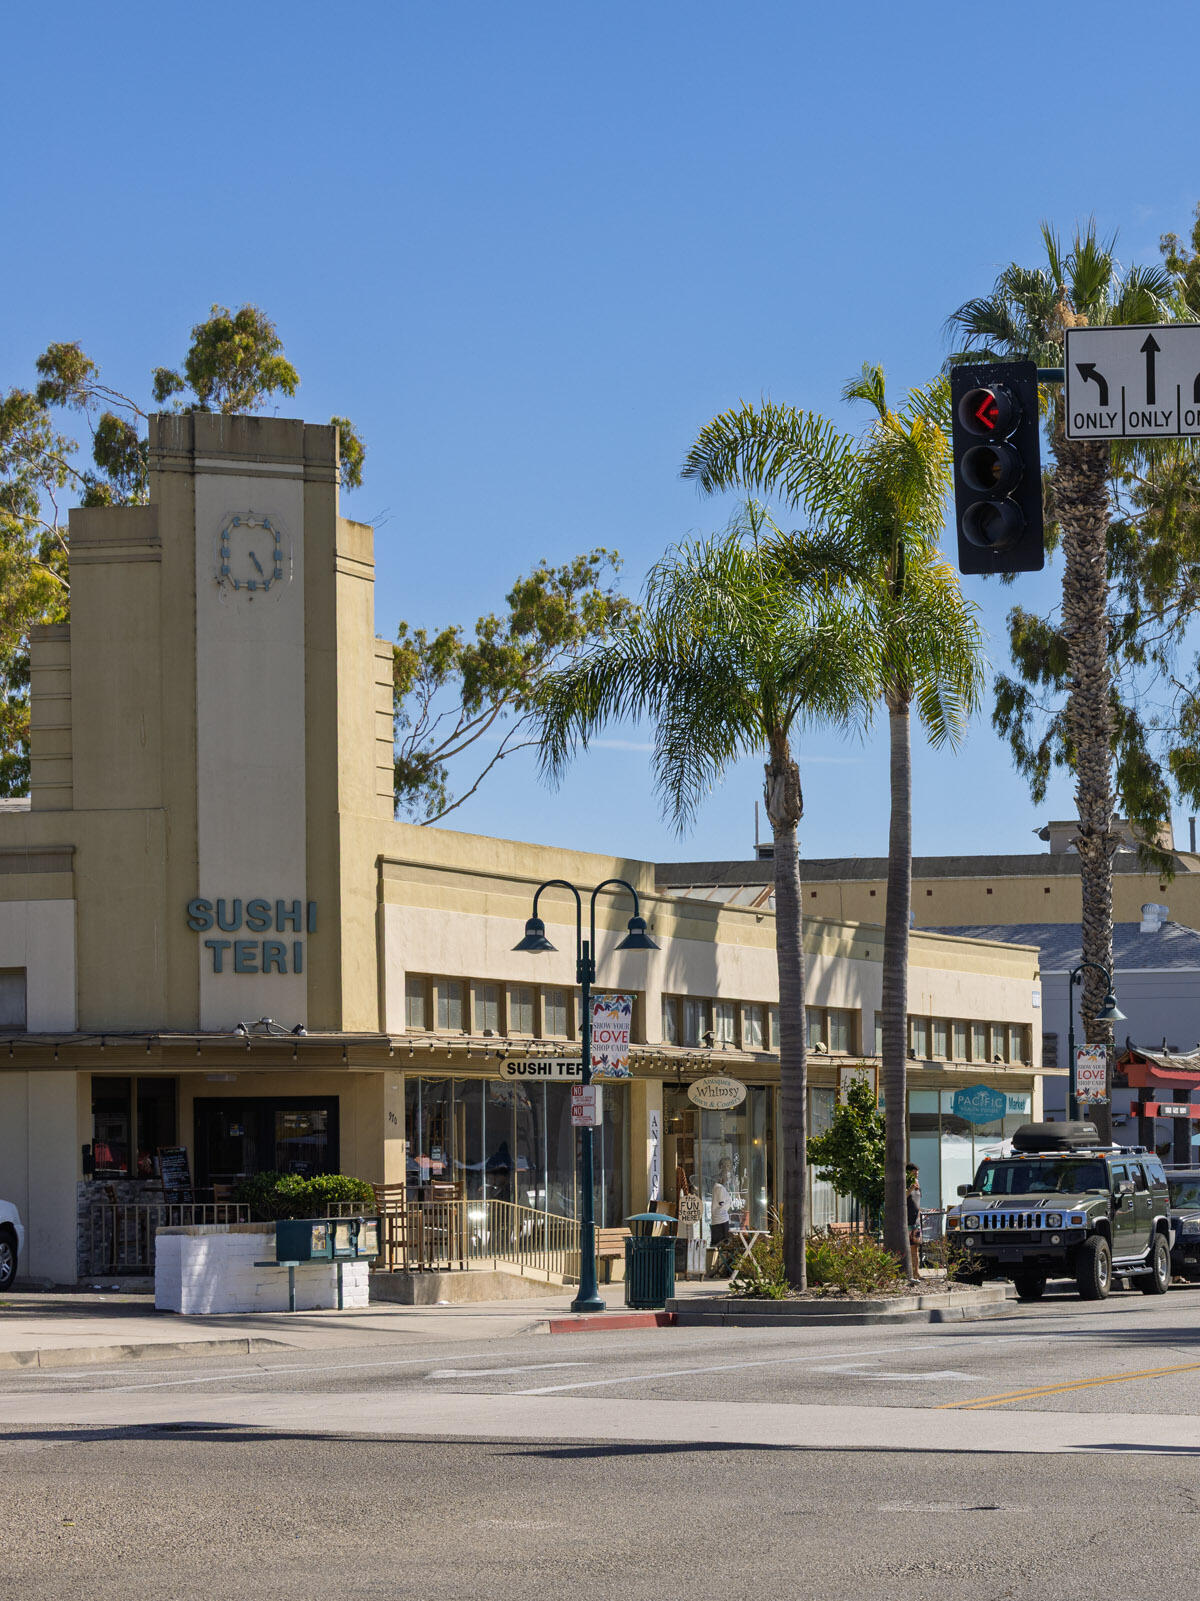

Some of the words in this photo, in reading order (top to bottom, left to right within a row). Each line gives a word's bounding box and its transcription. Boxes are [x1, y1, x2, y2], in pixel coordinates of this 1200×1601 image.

[1074, 412, 1118, 429] ONLY
[1129, 411, 1173, 428] ONLY
[187, 899, 317, 934] SUSHI
[205, 940, 303, 973] TERI
[593, 1030, 628, 1043] LOVE
[507, 1062, 552, 1075] SUSHI
[1078, 1070, 1104, 1080] LOVE
[573, 1086, 582, 1096] NO
[696, 1085, 739, 1098] Whimsy
[958, 1095, 1003, 1108] PACIFIC
[573, 1106, 582, 1116] NO
[680, 1202, 699, 1211] FUN
